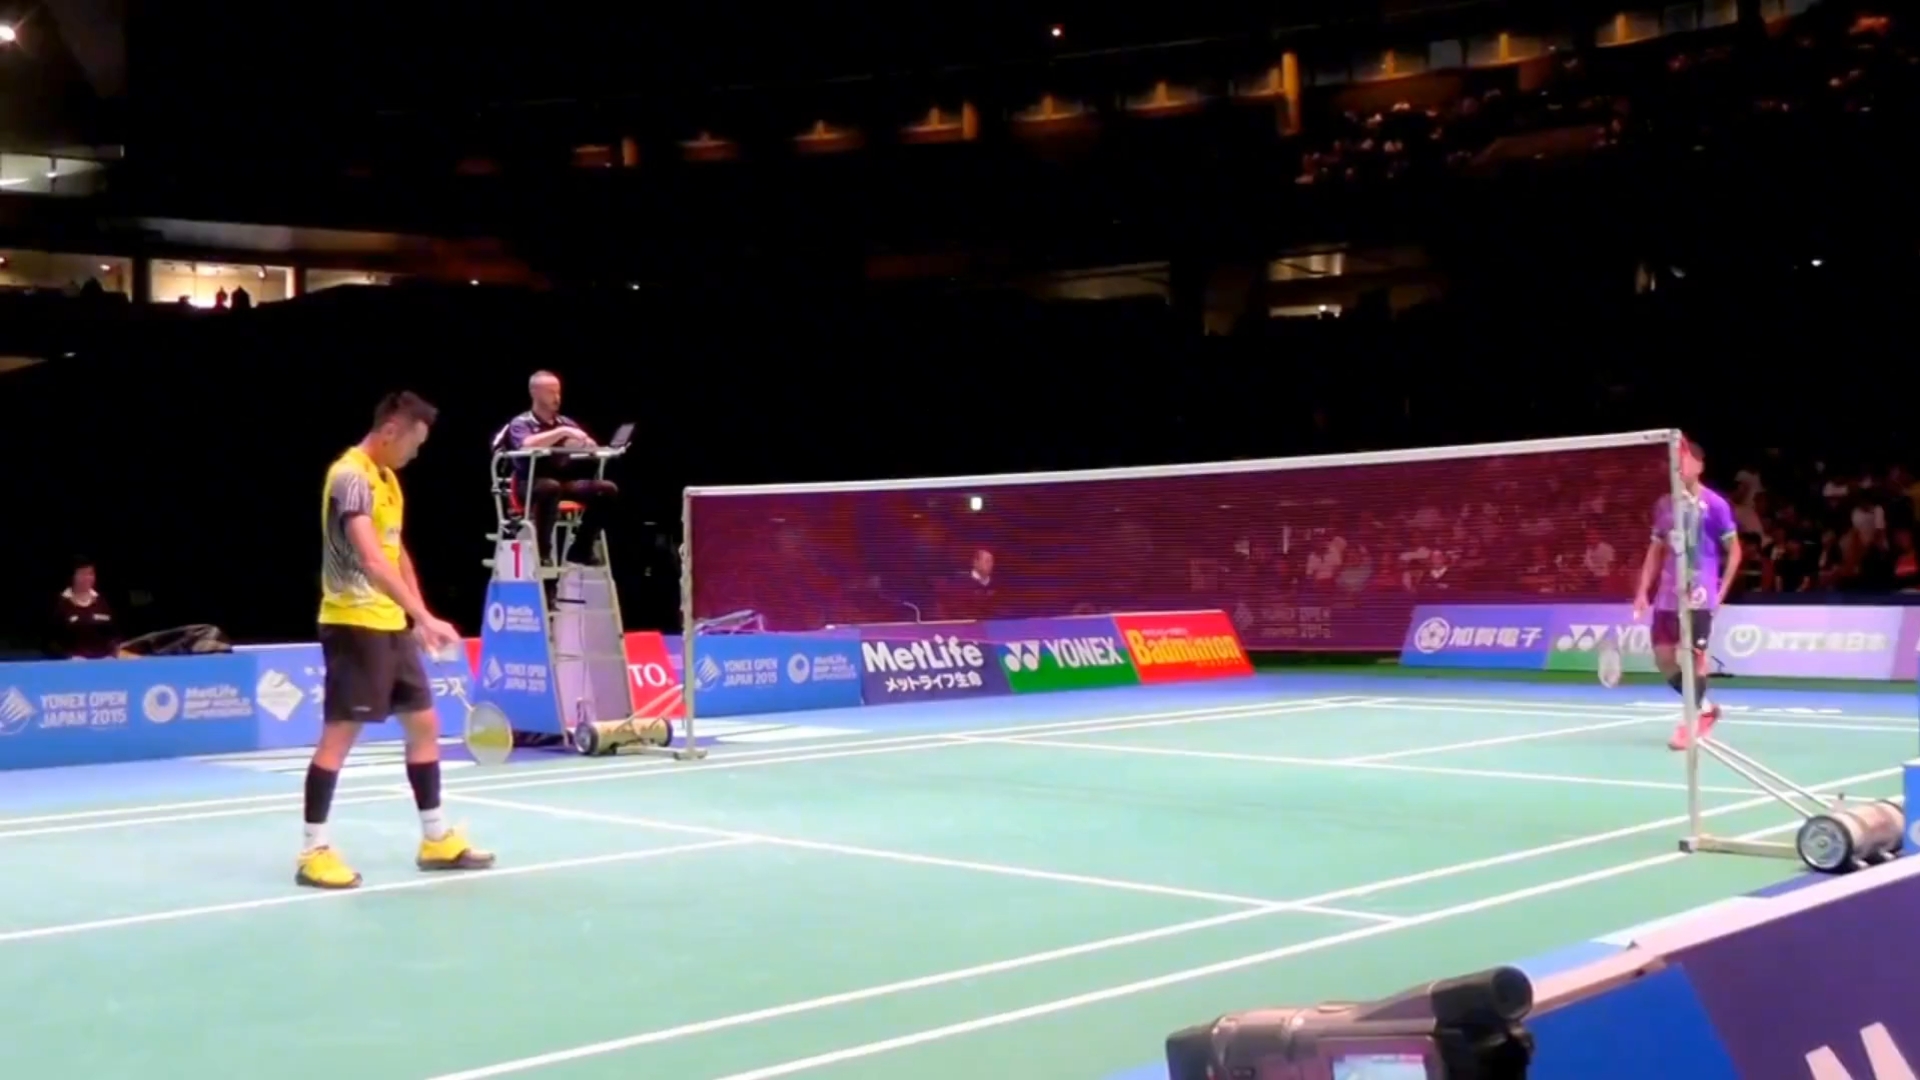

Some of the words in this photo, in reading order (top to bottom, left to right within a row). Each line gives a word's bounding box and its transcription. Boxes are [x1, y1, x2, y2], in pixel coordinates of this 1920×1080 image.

[511, 541, 521, 579] 1
[1124, 628, 1242, 666] Badminton
[1450, 627, 1542, 648] 加賀電子
[862, 634, 984, 673] MetLife
[1043, 635, 1125, 669] YONEX
[723, 659, 753, 672] YONEX
[754, 657, 778, 670] OPEN
[754, 671, 778, 684] 2015
[885, 670, 983, 693] メットライフ生命
[40, 693, 86, 710] YONEX
[89, 690, 128, 706] OPEN
[38, 709, 86, 729] JAPAN
[91, 707, 128, 725] 2015
